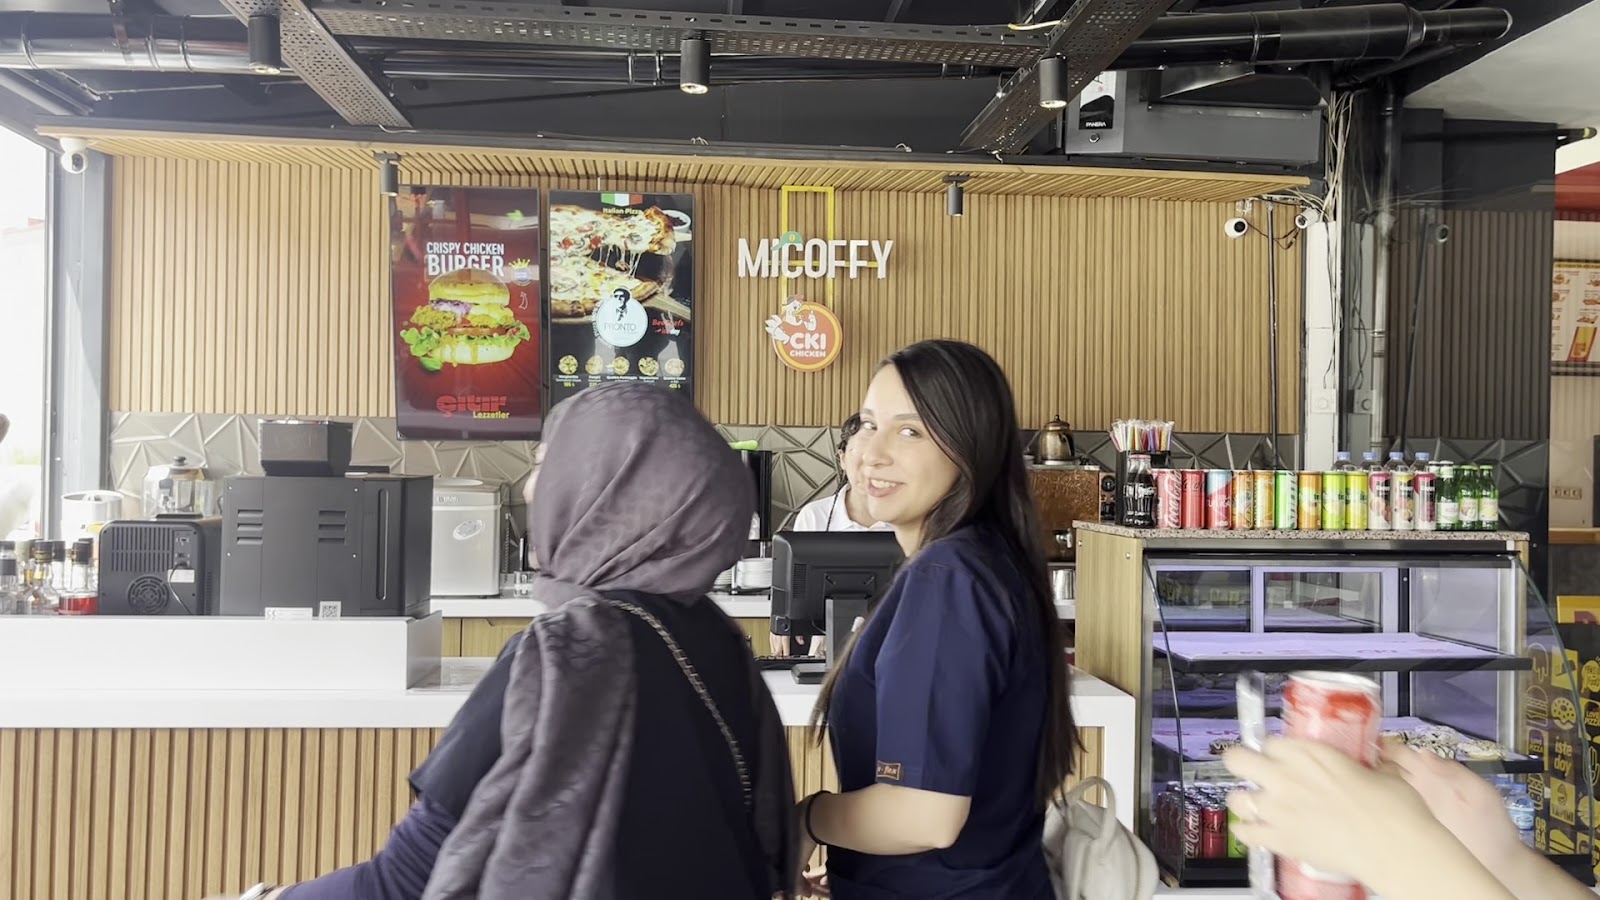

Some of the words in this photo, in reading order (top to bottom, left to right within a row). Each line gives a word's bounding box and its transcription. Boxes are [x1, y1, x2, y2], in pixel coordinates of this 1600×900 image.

[602, 207, 624, 215] Italian
[426, 242, 461, 254] CRISPY
[463, 243, 505, 255] CHICKEN
[428, 254, 505, 277] BURGER
[604, 323, 637, 331] PRONTO
[789, 332, 827, 350] CKI
[789, 350, 826, 358] CHICKEN
[472, 410, 510, 419] Lezzetler
[1554, 735, 1573, 757] iste
[1554, 755, 1572, 778] doy
